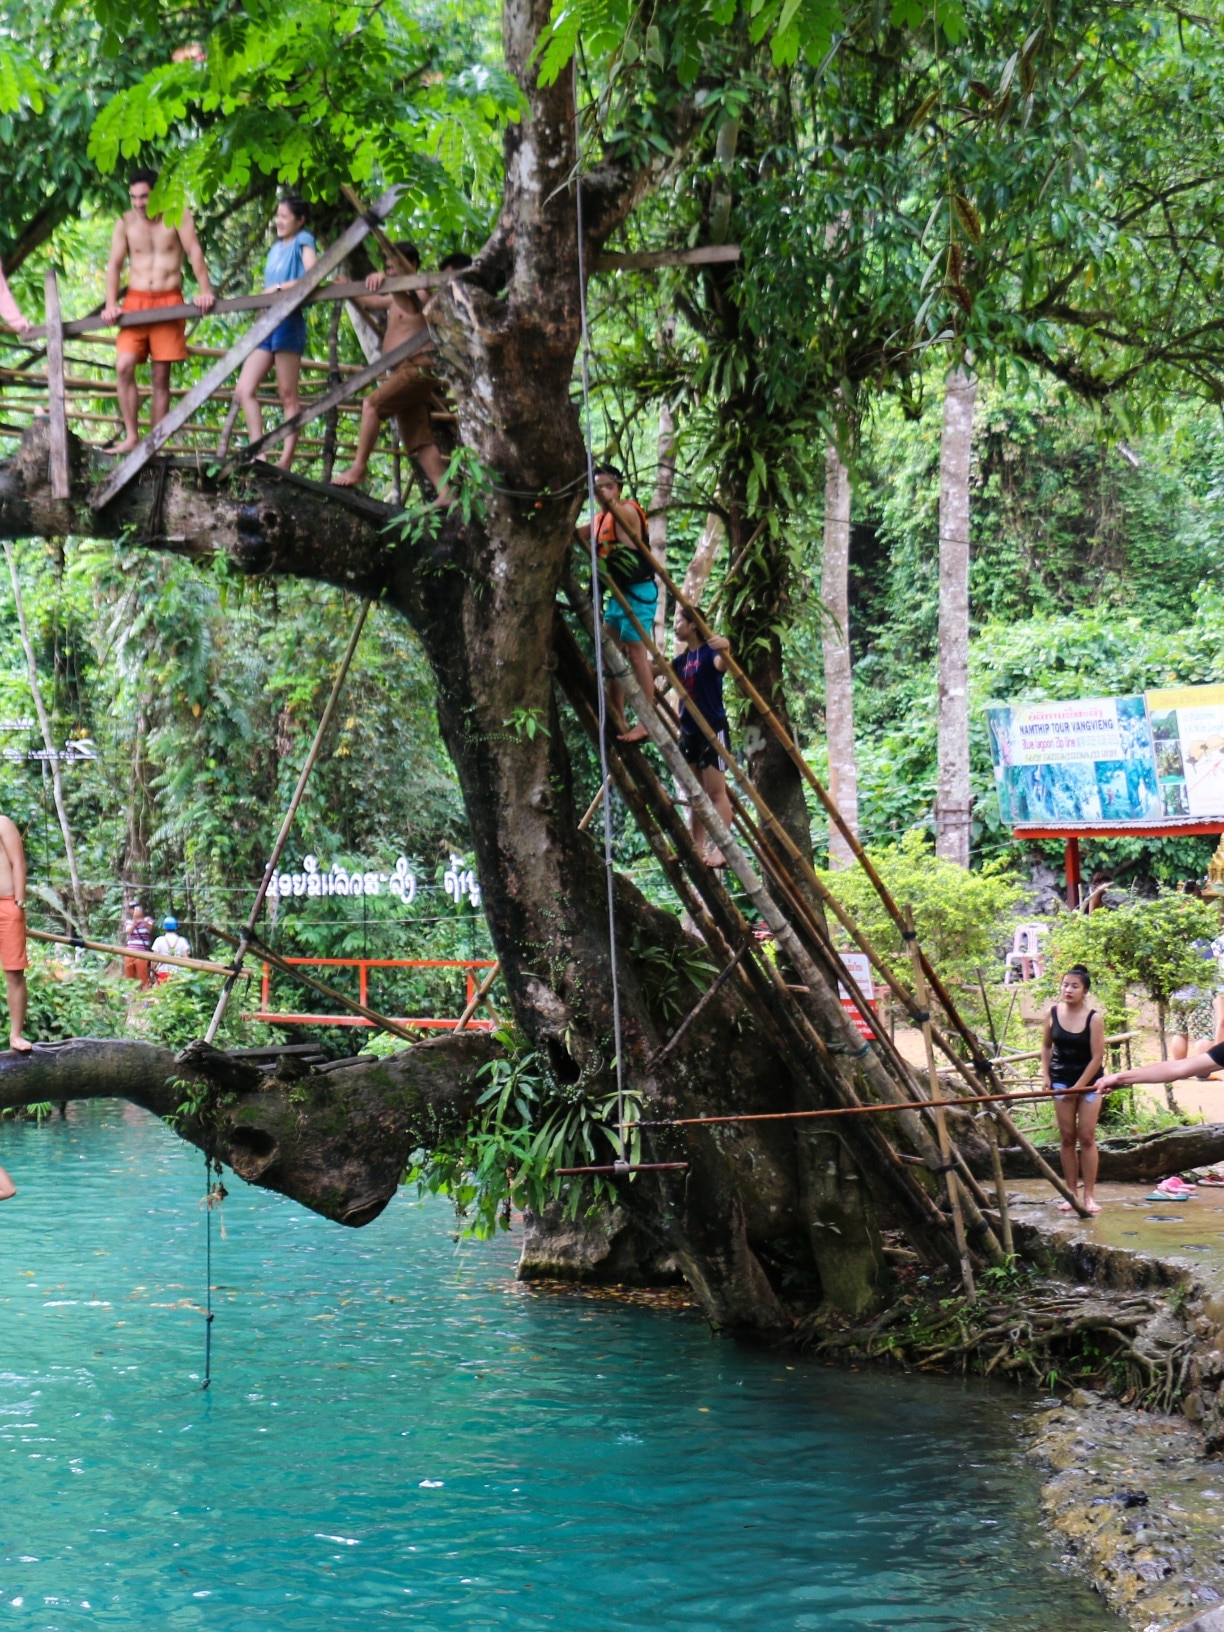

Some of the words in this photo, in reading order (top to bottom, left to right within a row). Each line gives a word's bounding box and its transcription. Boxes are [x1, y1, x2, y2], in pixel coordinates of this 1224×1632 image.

[1019, 723, 1050, 735] NAMTHIP
[1051, 722, 1070, 733] TOUR
[1072, 718, 1114, 731] VANGVIENG
[1021, 738, 1035, 750] Blue
